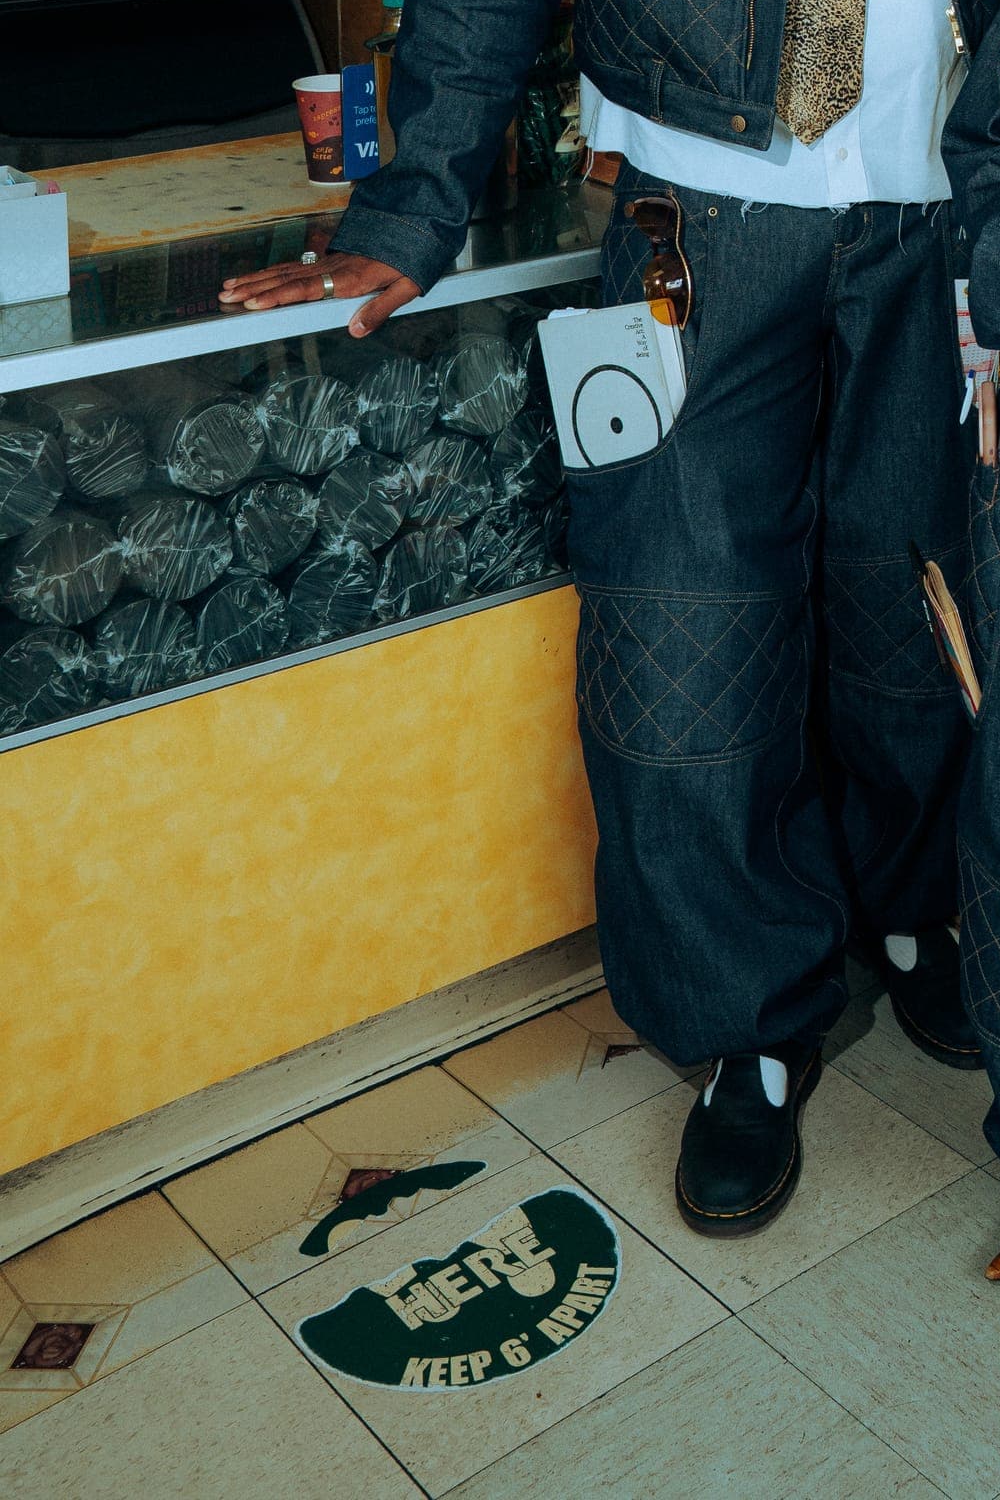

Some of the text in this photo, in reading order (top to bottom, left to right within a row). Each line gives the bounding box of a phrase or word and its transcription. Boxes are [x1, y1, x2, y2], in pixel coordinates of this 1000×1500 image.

[353, 106, 368, 116] Tap
[385, 1225, 556, 1331] HERE
[400, 1349, 493, 1388] KEEP
[536, 1263, 617, 1346] APART
